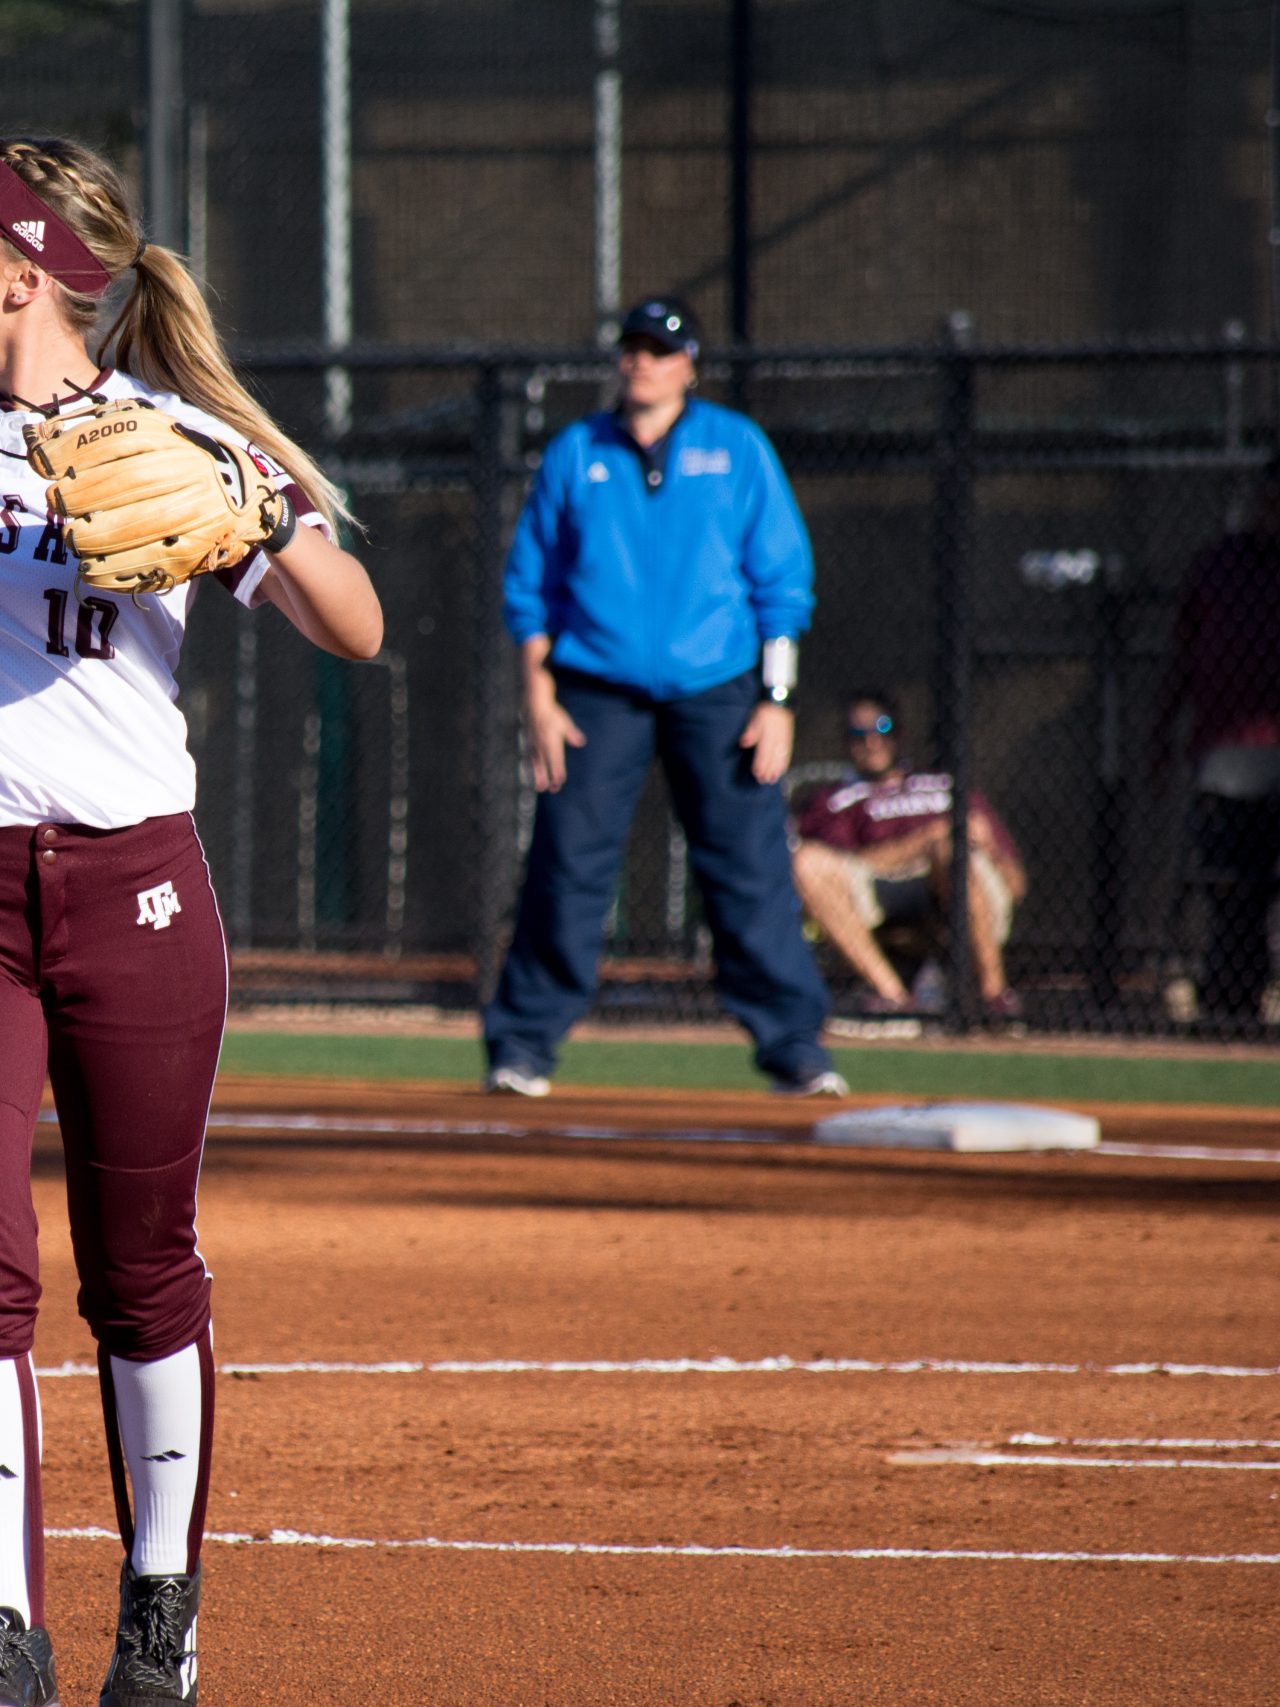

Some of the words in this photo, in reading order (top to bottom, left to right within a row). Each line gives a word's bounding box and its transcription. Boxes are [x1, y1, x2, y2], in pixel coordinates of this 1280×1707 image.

[12, 222, 45, 252] adidas
[76, 420, 138, 450] A2000
[43, 588, 119, 660] 10
